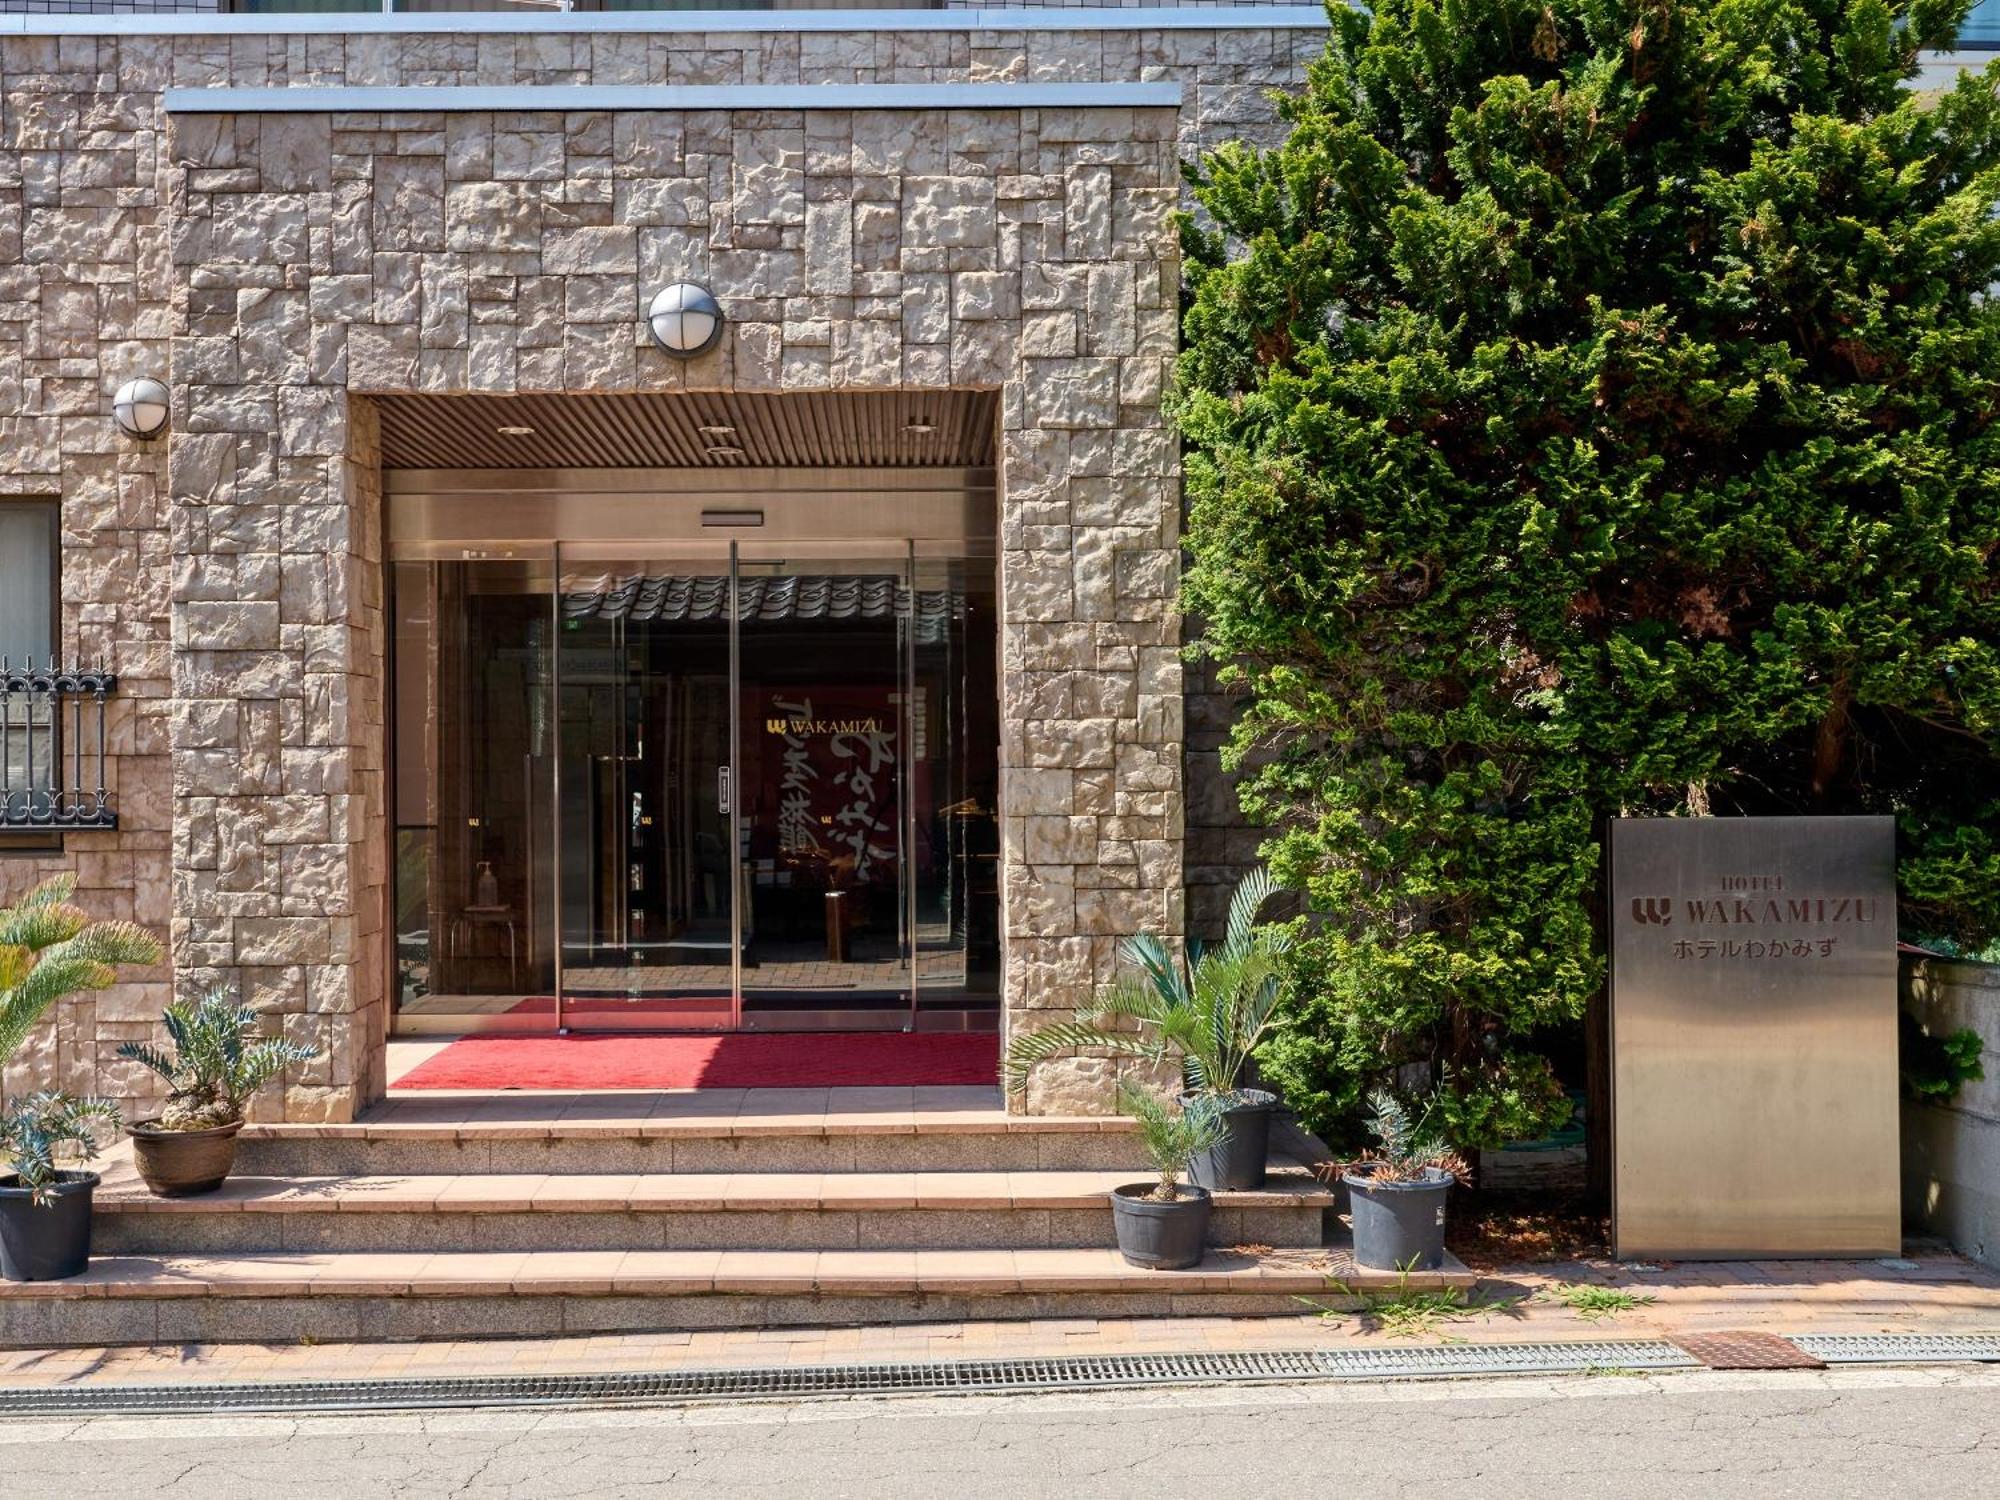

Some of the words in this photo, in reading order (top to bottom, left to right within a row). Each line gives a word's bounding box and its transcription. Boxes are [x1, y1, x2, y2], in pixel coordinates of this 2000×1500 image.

[790, 719, 882, 734] WAKAMIZU
[1721, 876, 1783, 891] HOTEL
[1687, 898, 1876, 924] WAKAMIZU
[1673, 937, 1838, 959] ホテルわかみず
